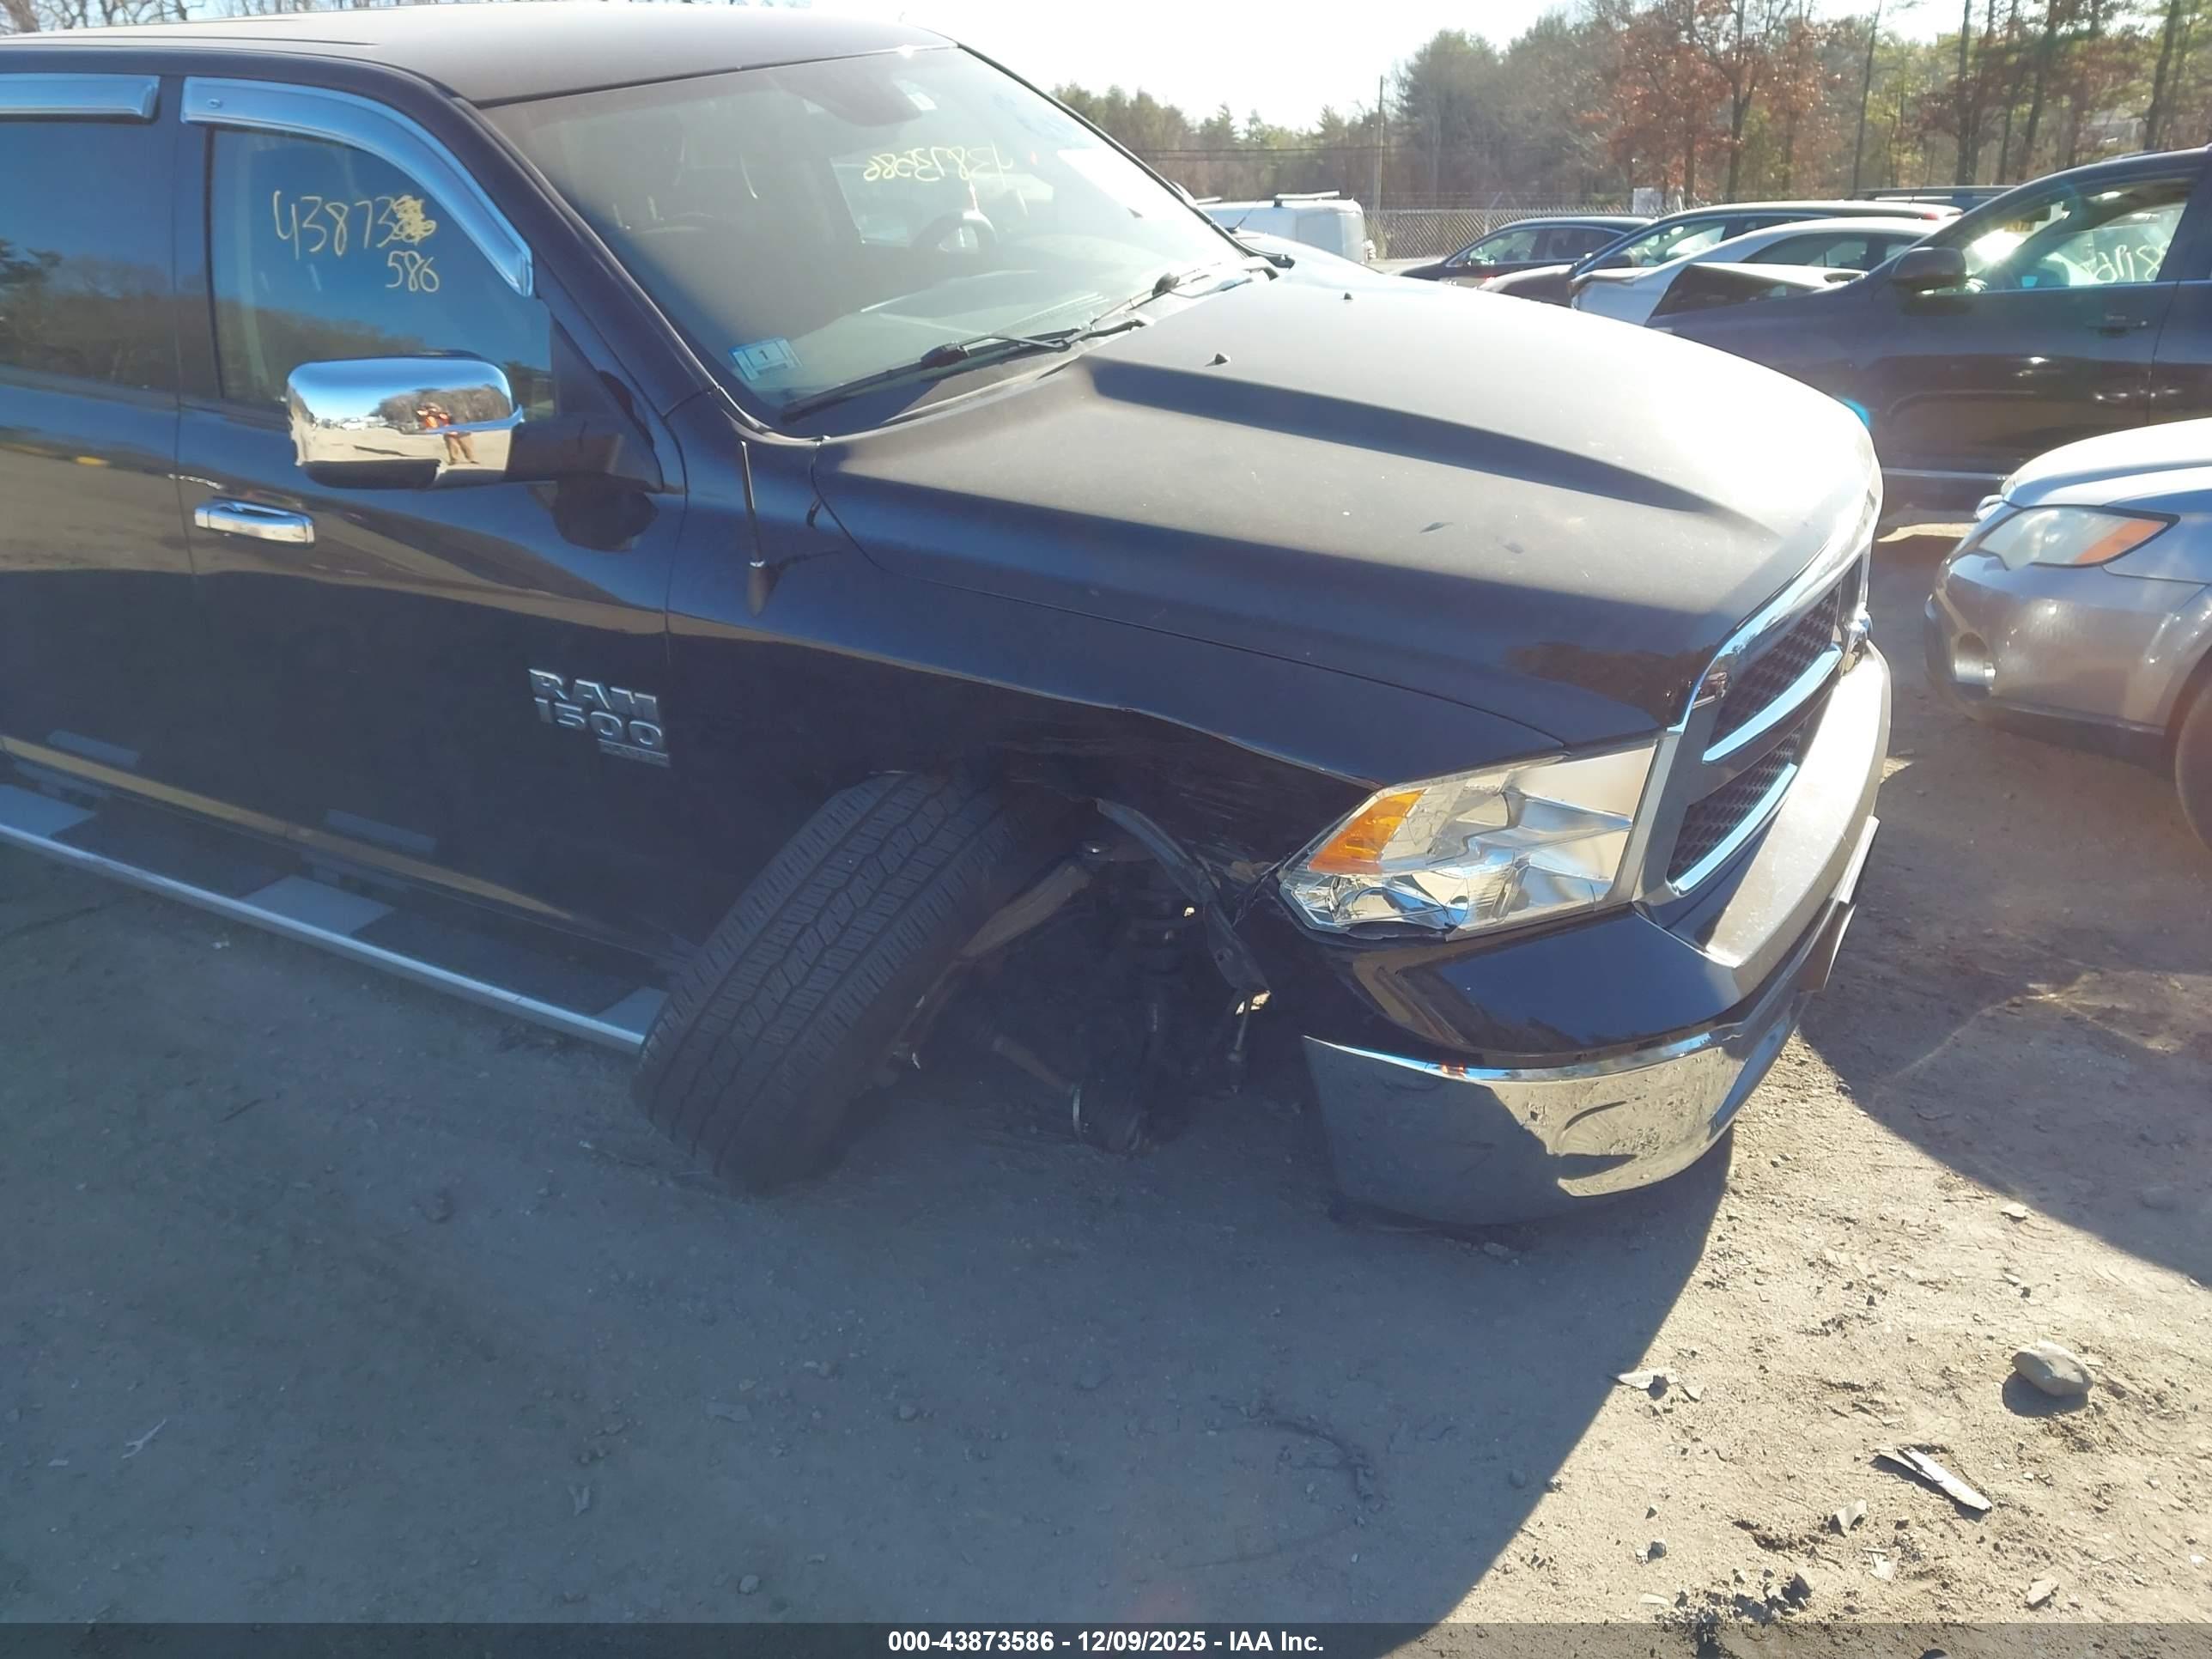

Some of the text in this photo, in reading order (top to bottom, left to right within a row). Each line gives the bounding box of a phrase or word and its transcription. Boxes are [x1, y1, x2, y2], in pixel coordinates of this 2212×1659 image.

[386, 250, 440, 292] 586
[529, 668, 660, 723] RAM
[534, 696, 665, 749] 1500
